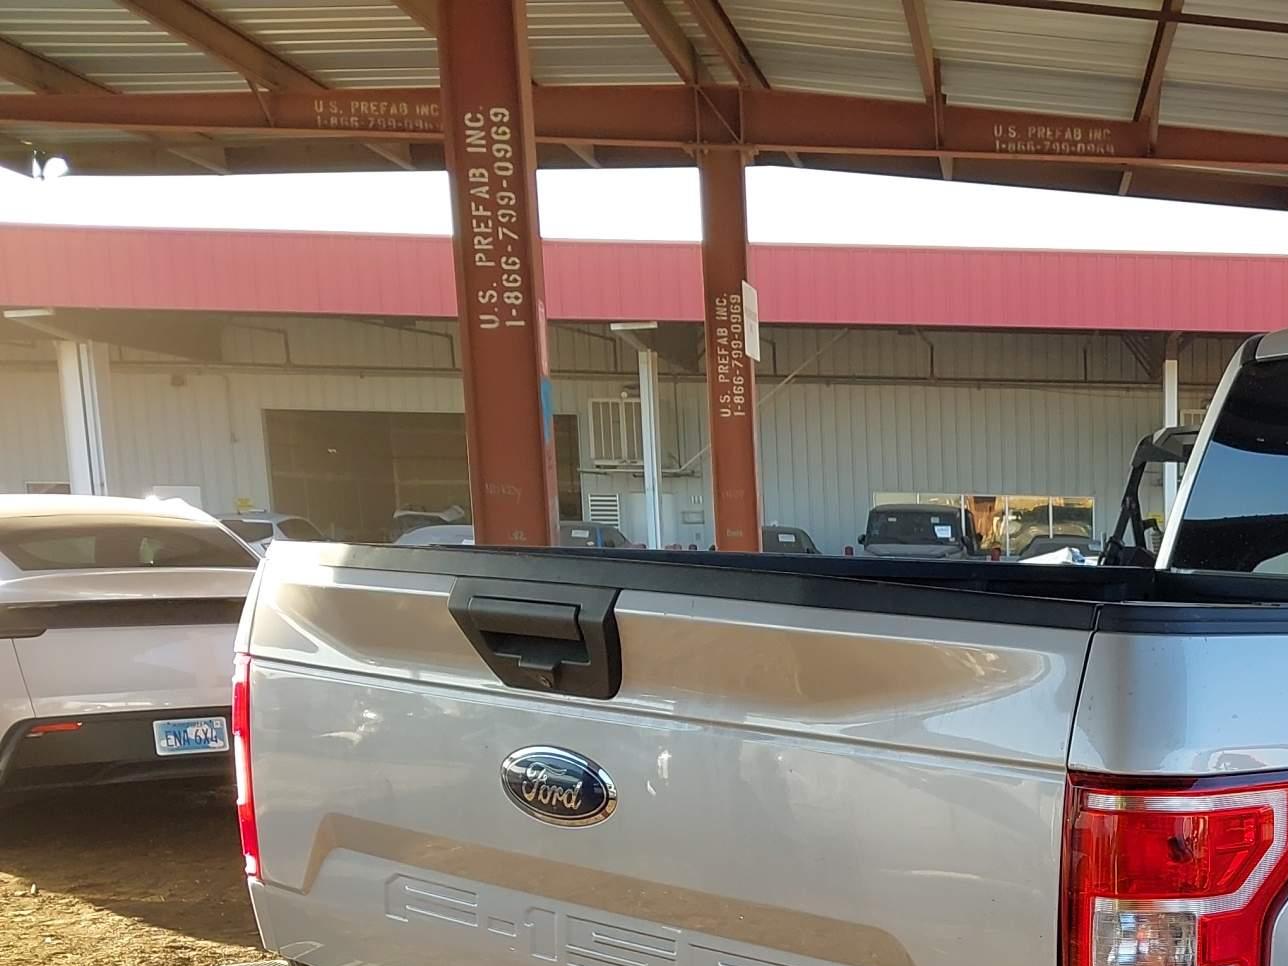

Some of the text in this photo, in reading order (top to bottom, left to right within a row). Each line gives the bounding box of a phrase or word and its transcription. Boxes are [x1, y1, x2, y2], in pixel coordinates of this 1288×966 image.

[351, 101, 408, 116] PREFAB
[1028, 126, 1082, 140] PREFAB
[464, 105, 500, 329] U.S. PREFAB INC.
[489, 106, 526, 328] 1-866-799-0969
[715, 293, 732, 417] U.S. PREFAB INC.
[729, 294, 746, 417] 1-866-799-0969
[165, 729, 190, 747] ENA
[522, 761, 583, 810] Ford
